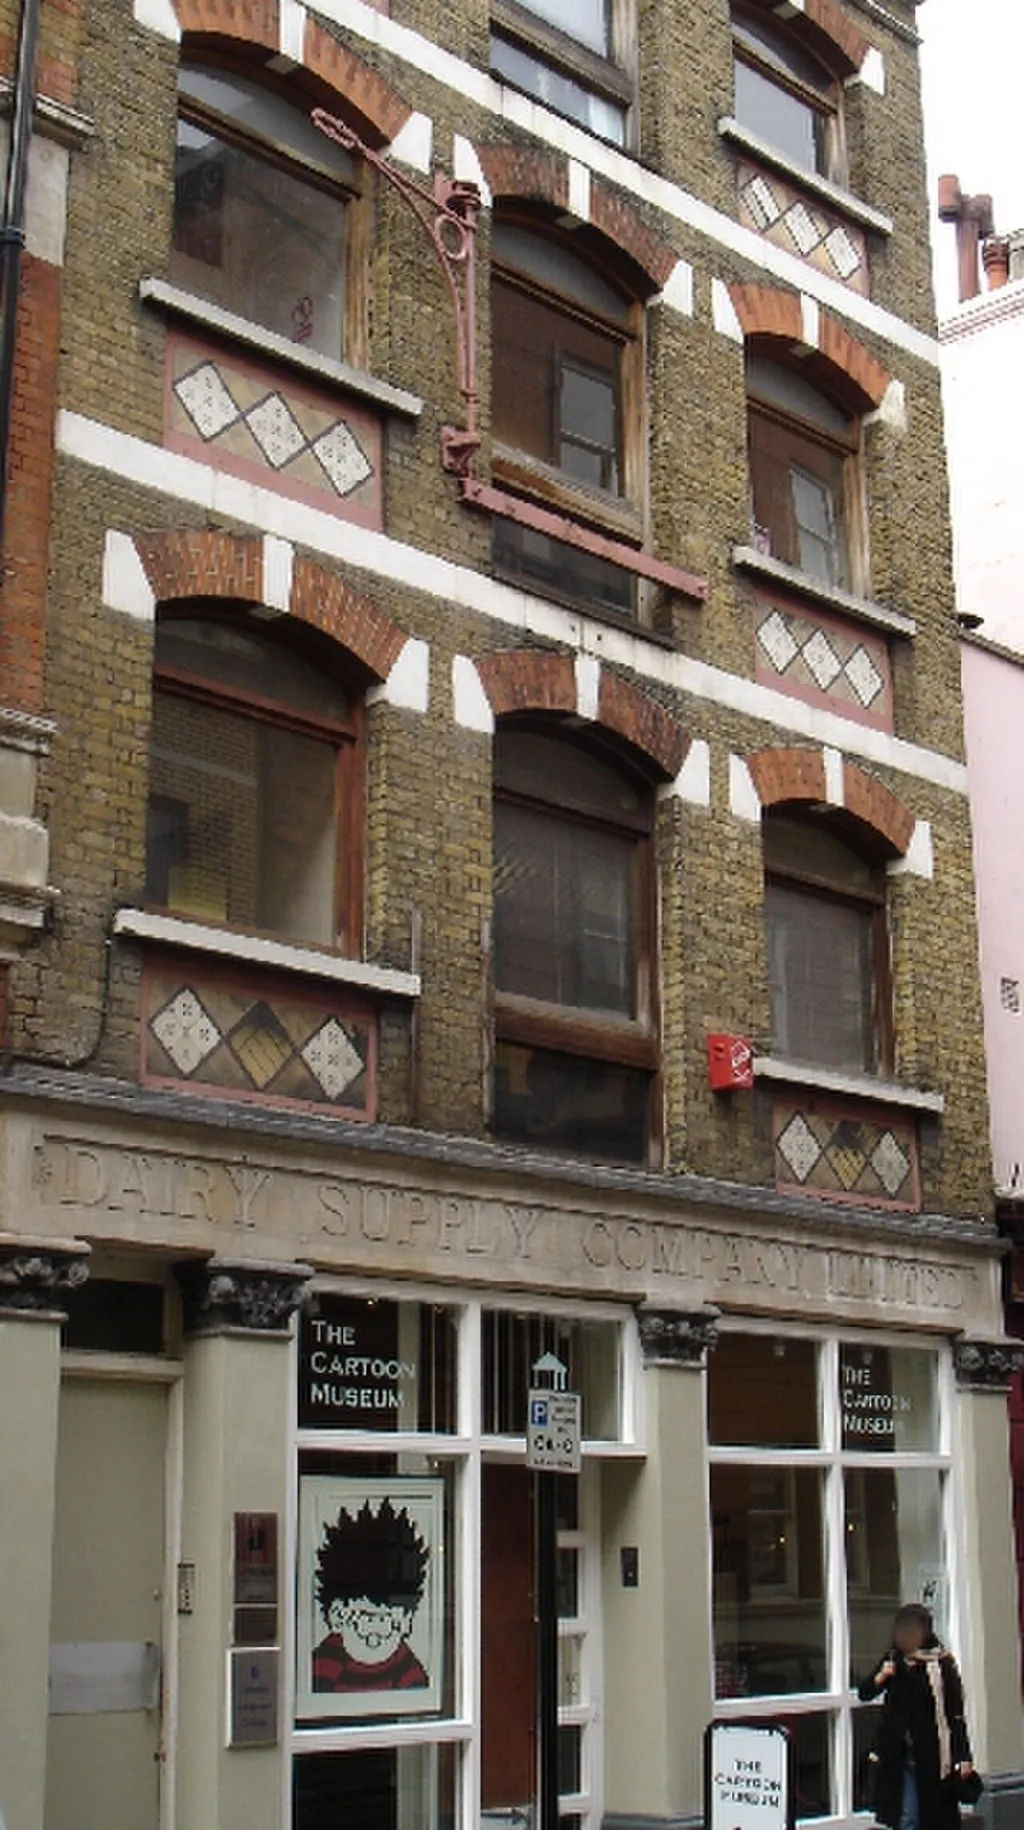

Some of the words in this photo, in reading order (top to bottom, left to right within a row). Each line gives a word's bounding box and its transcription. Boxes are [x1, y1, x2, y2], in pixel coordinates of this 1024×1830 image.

[61, 1146, 273, 1228] DAIRY
[319, 1183, 542, 1260] SUPPLY
[582, 1222, 806, 1291] COMPANY
[311, 1320, 356, 1346] THE
[311, 1351, 416, 1379] CARTOON
[311, 1382, 404, 1408] MUSEUM
[534, 1402, 547, 1424] P
[843, 1413, 905, 1434] MUSEU
[734, 1759, 762, 1773] THE
